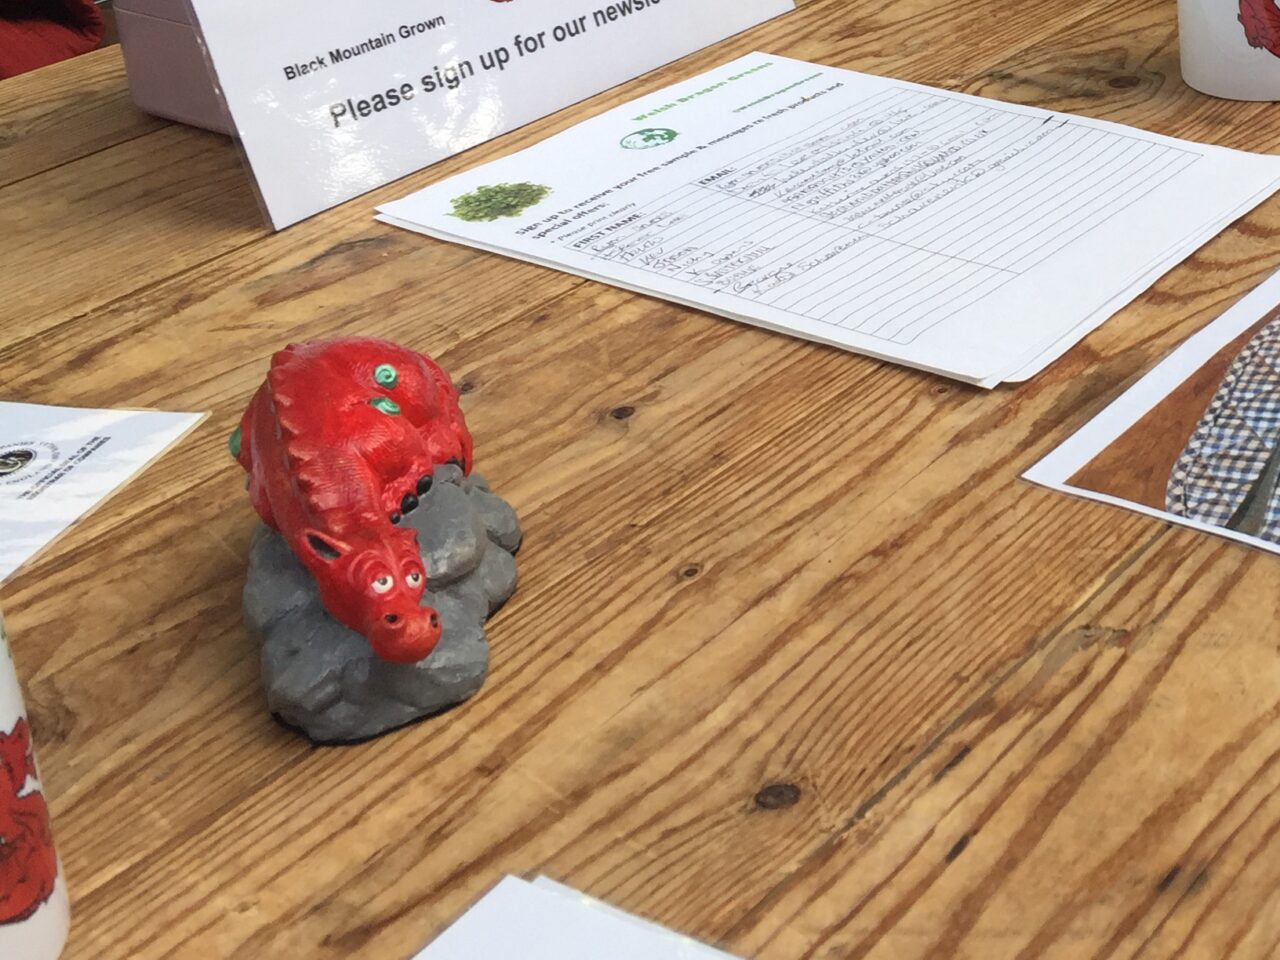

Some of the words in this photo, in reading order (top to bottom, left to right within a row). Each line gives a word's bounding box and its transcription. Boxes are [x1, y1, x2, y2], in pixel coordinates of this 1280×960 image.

[283, 55, 328, 81] Black
[329, 32, 396, 65] Mountain
[398, 14, 446, 40] Grown
[329, 82, 415, 128] Please
[421, 59, 475, 91] sign
[479, 44, 511, 72] up
[513, 31, 547, 58] for
[552, 15, 587, 43] our
[569, 188, 615, 208] receive
[610, 176, 642, 189] your
[635, 165, 663, 176] free
[657, 149, 700, 166] sample
[695, 166, 738, 184] EMAIL:
[526, 218, 577, 239] special
[569, 230, 609, 248] FIRST
[603, 211, 647, 231] NAME:
